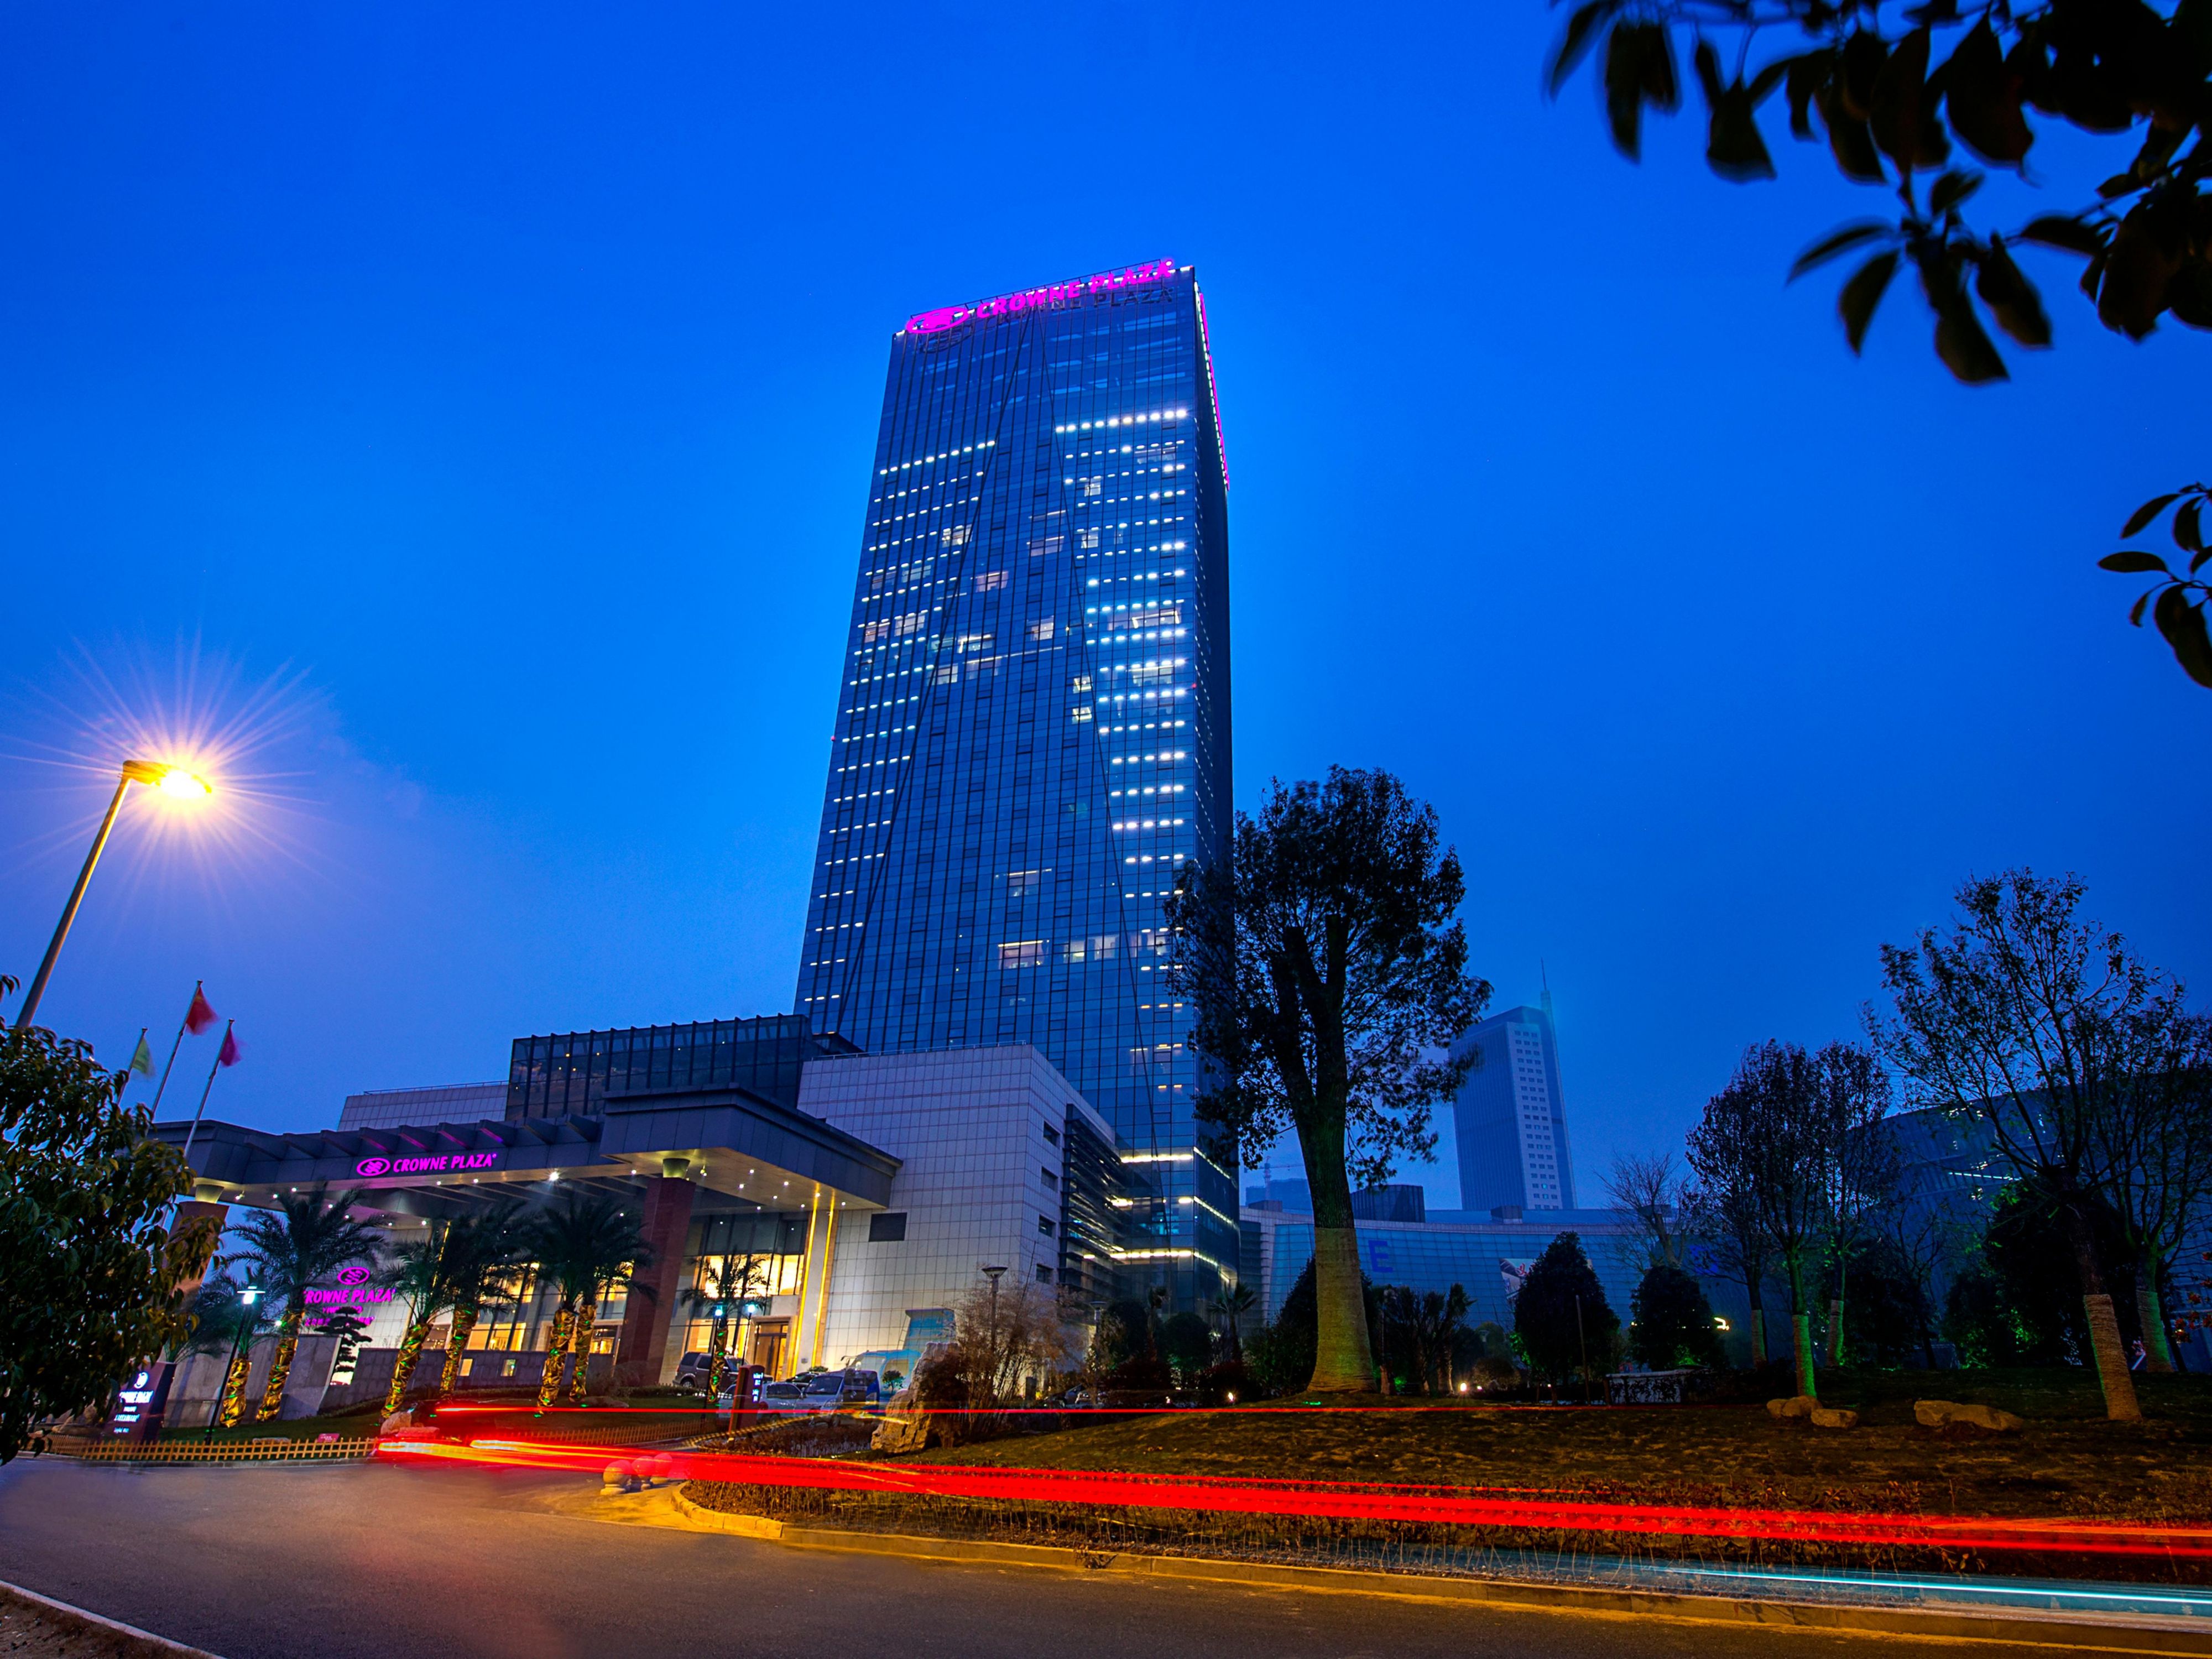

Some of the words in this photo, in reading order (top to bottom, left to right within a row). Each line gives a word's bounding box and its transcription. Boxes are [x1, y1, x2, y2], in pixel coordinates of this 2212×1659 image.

[977, 281, 1081, 319] CROWNE
[1091, 260, 1173, 293] PLAZA
[393, 1157, 447, 1172] CROWNE
[1368, 1240, 1393, 1273] E
[304, 1289, 349, 1303] ROWNE
